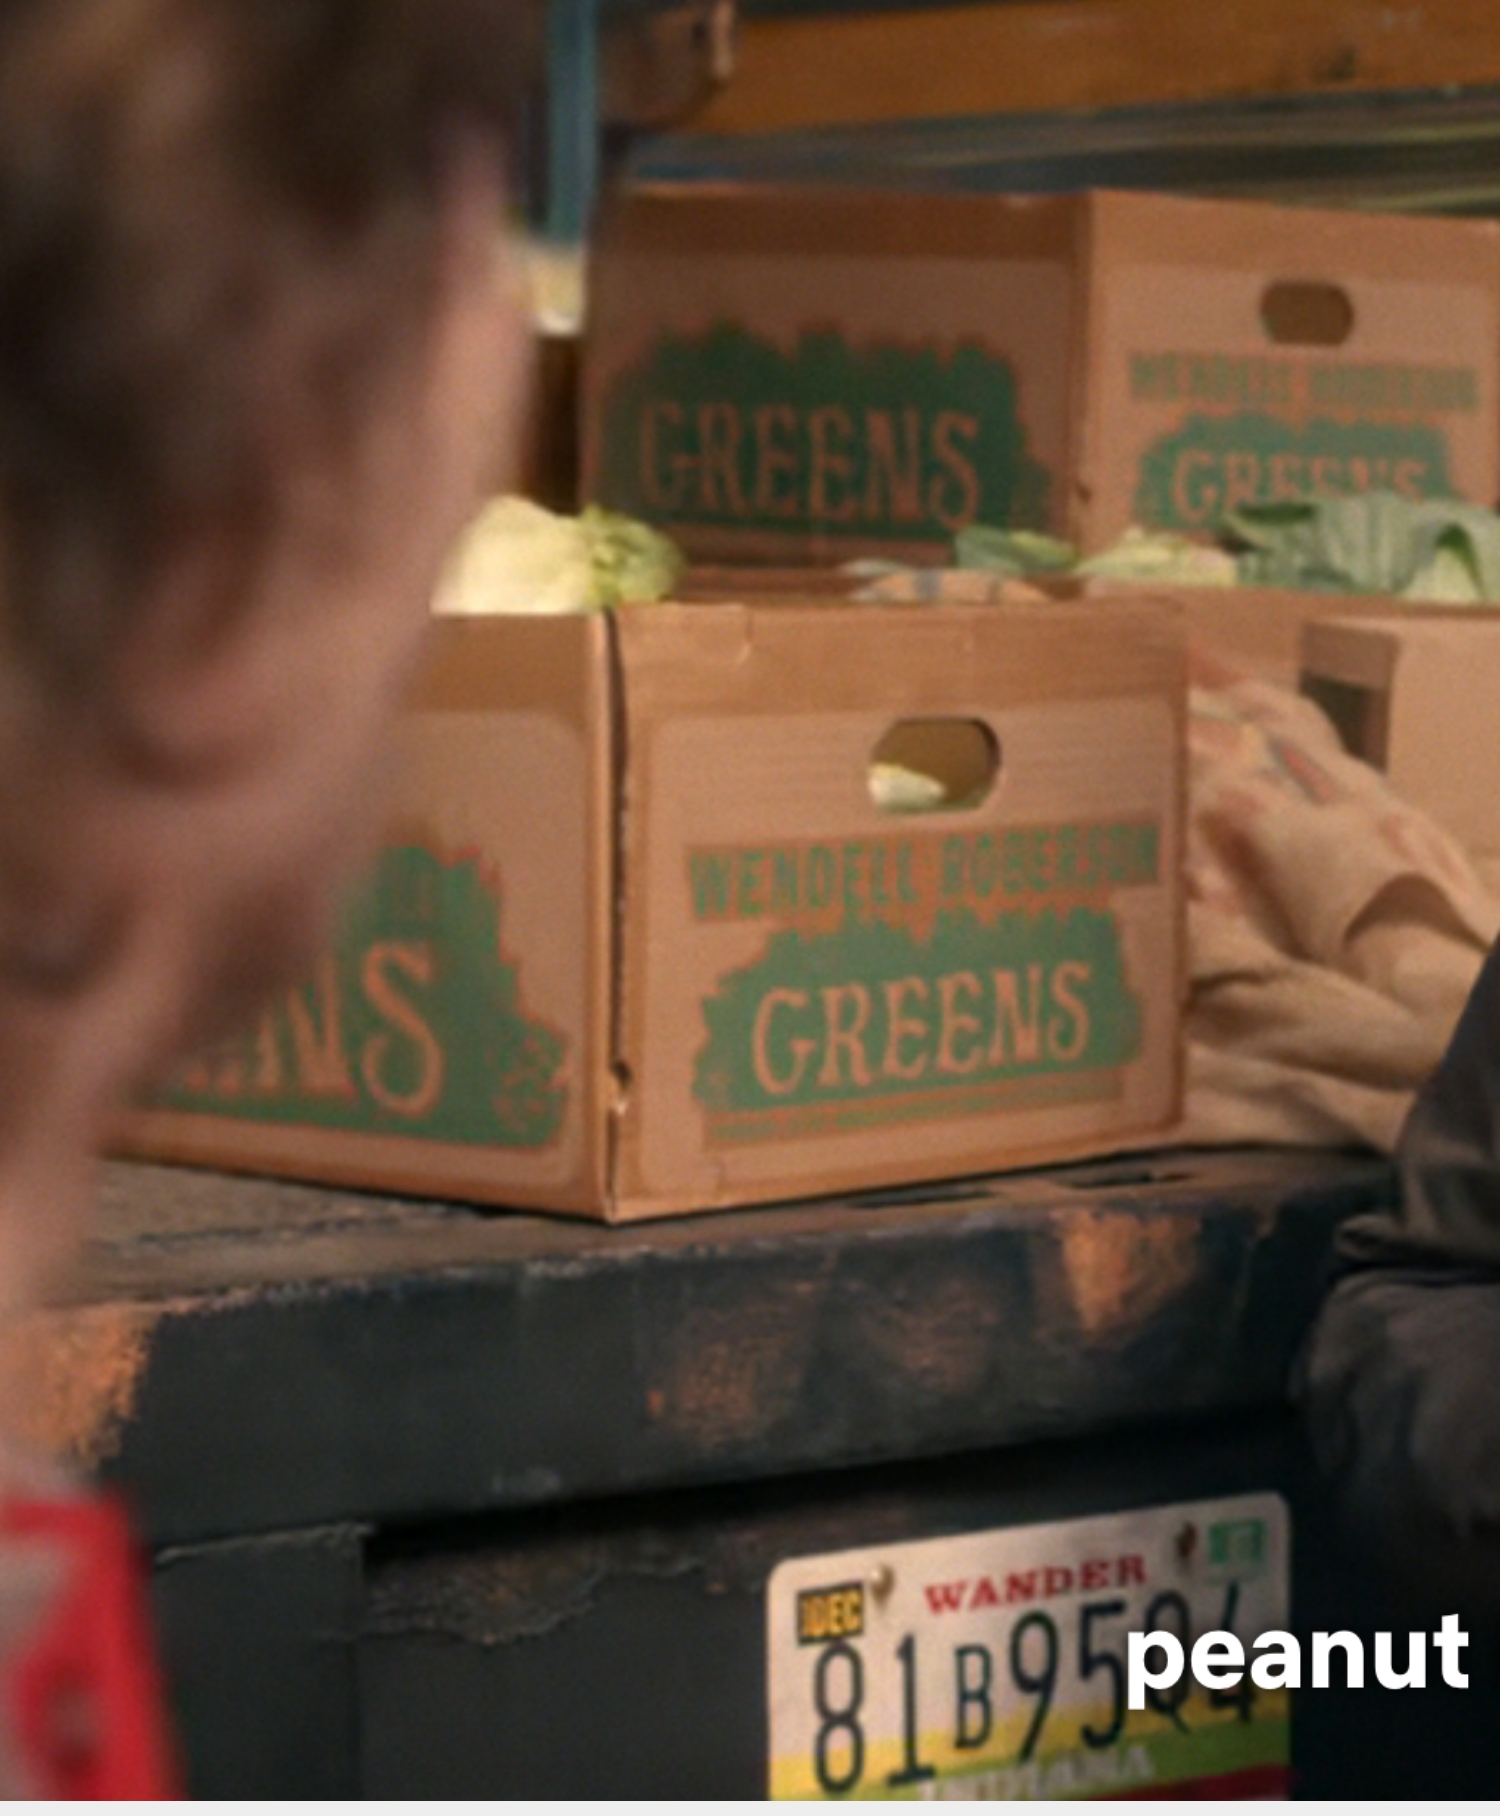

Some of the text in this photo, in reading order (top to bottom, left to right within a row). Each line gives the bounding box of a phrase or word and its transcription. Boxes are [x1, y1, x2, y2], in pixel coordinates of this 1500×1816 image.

[636, 400, 981, 530] GREENS
[689, 838, 918, 917] WENDELL
[751, 959, 1093, 1096] GREENS
[924, 1554, 1148, 1616] WANDER
